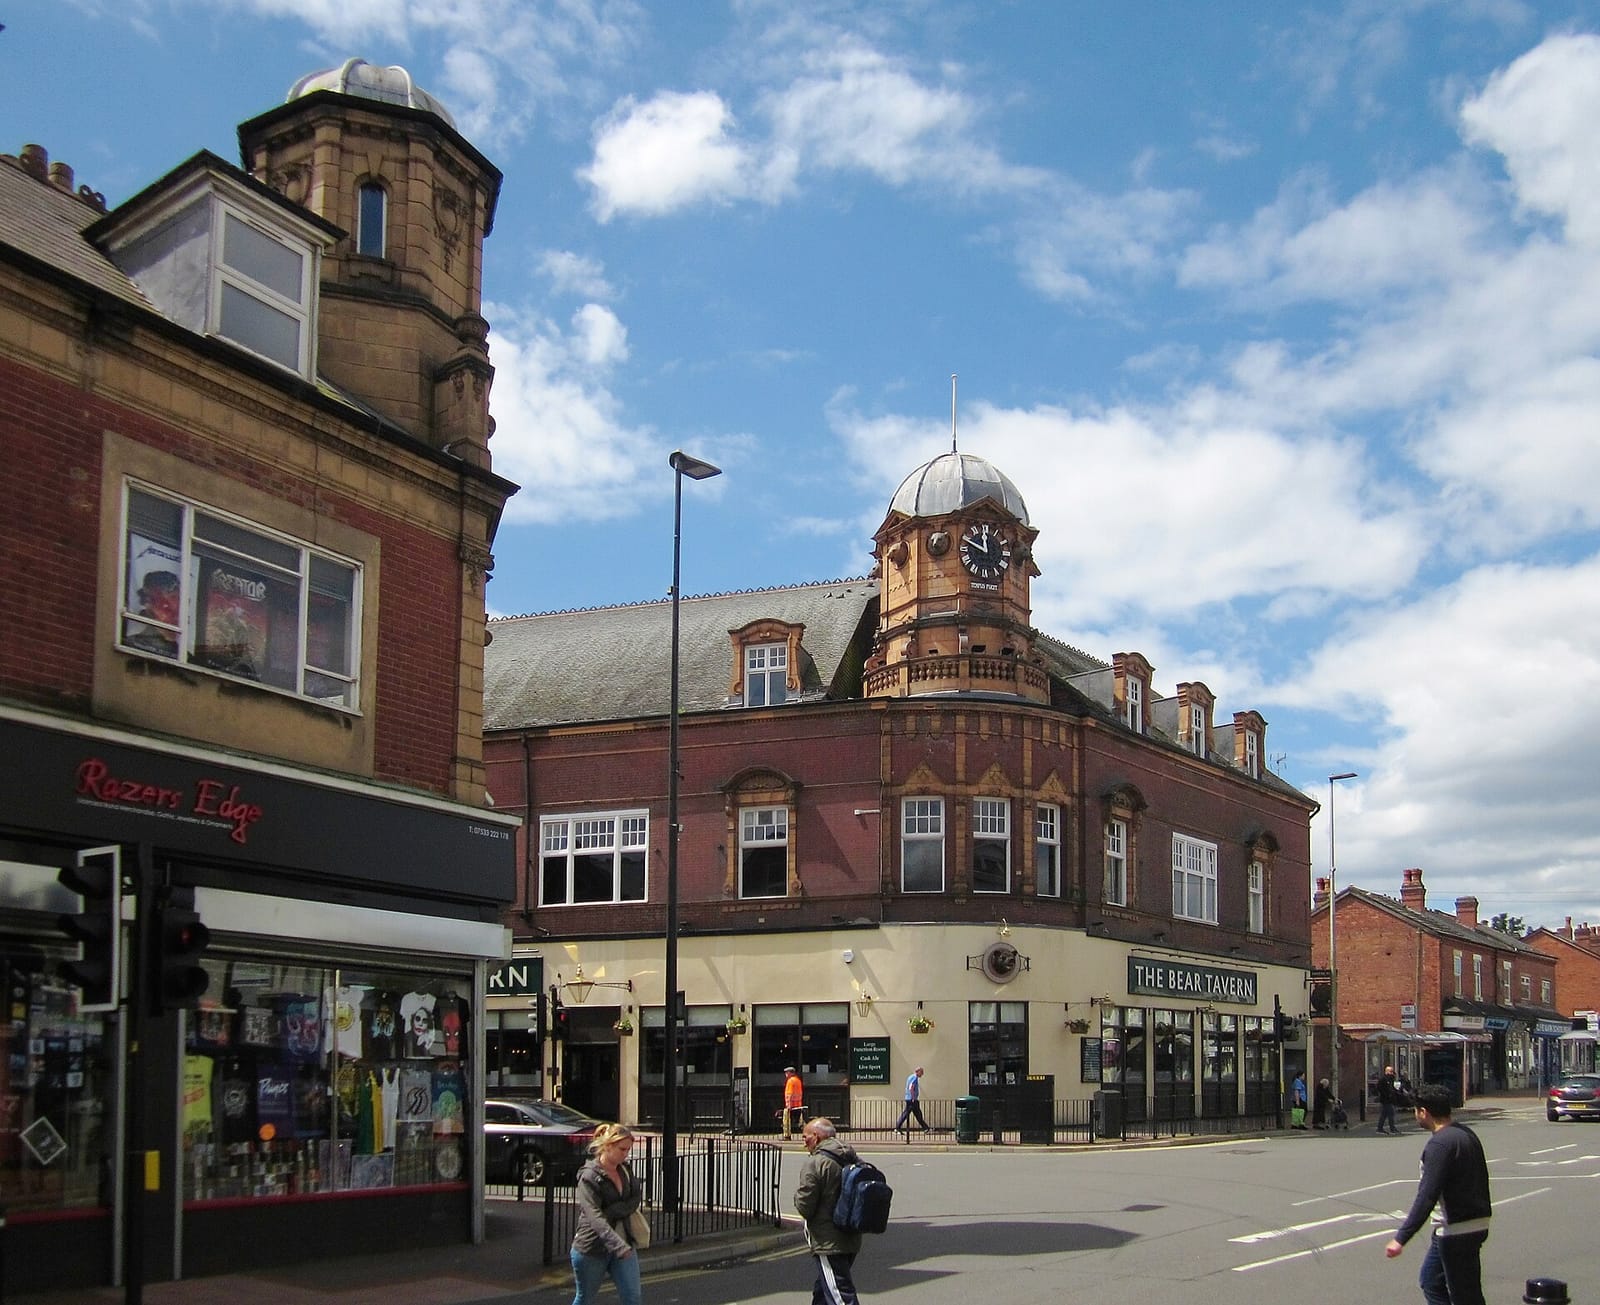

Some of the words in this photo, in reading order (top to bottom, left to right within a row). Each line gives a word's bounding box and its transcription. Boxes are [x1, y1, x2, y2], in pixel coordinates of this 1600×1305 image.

[76, 757, 184, 809] Razers
[193, 778, 264, 845] Edge
[490, 830, 499, 839] 222
[1135, 965, 1164, 989] THE
[1168, 970, 1202, 993] BEAR
[1205, 974, 1254, 997] TAVERN
